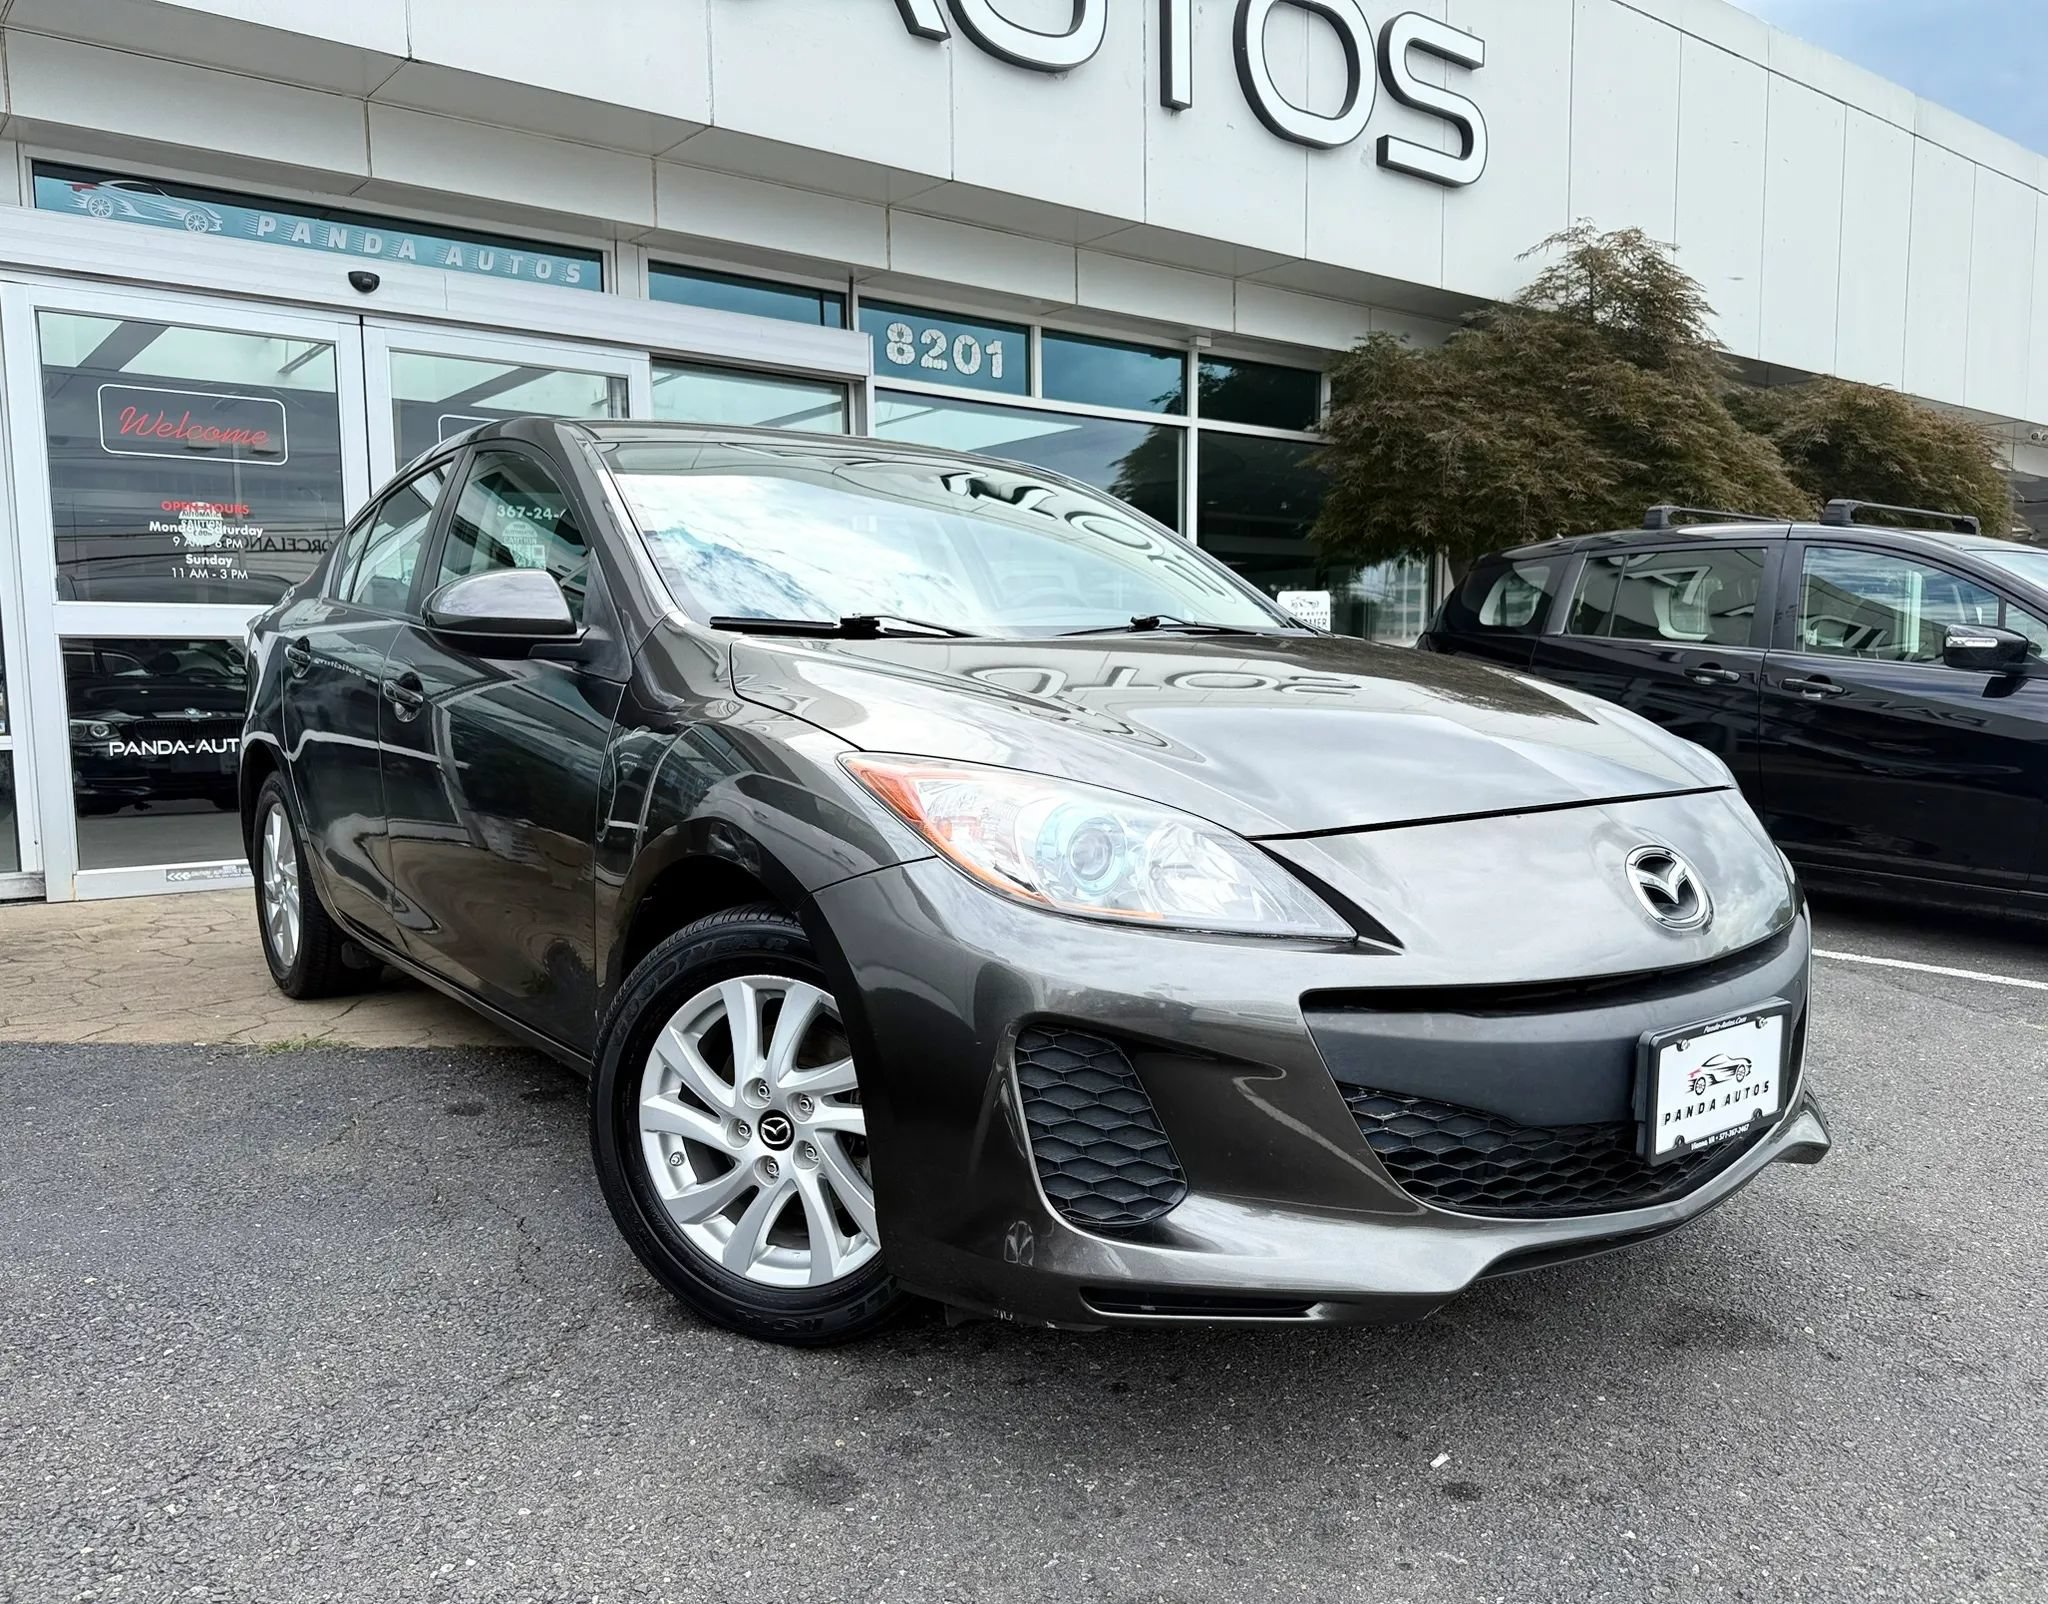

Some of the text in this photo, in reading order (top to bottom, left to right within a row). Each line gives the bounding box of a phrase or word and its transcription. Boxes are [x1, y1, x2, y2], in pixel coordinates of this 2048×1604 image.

[257, 215, 580, 283] PANDA AUTOS
[886, 322, 1002, 378] 8201
[119, 406, 270, 445] Welcome
[172, 536, 180, 547] 9
[215, 538, 222, 548] 6
[226, 539, 243, 549] PM
[185, 553, 233, 568] Sunday
[172, 568, 185, 578] 11
[189, 568, 209, 579] AM
[220, 568, 227, 579] 3
[231, 569, 248, 580] PM
[1664, 1080, 1770, 1125] PANDA AUTOS
